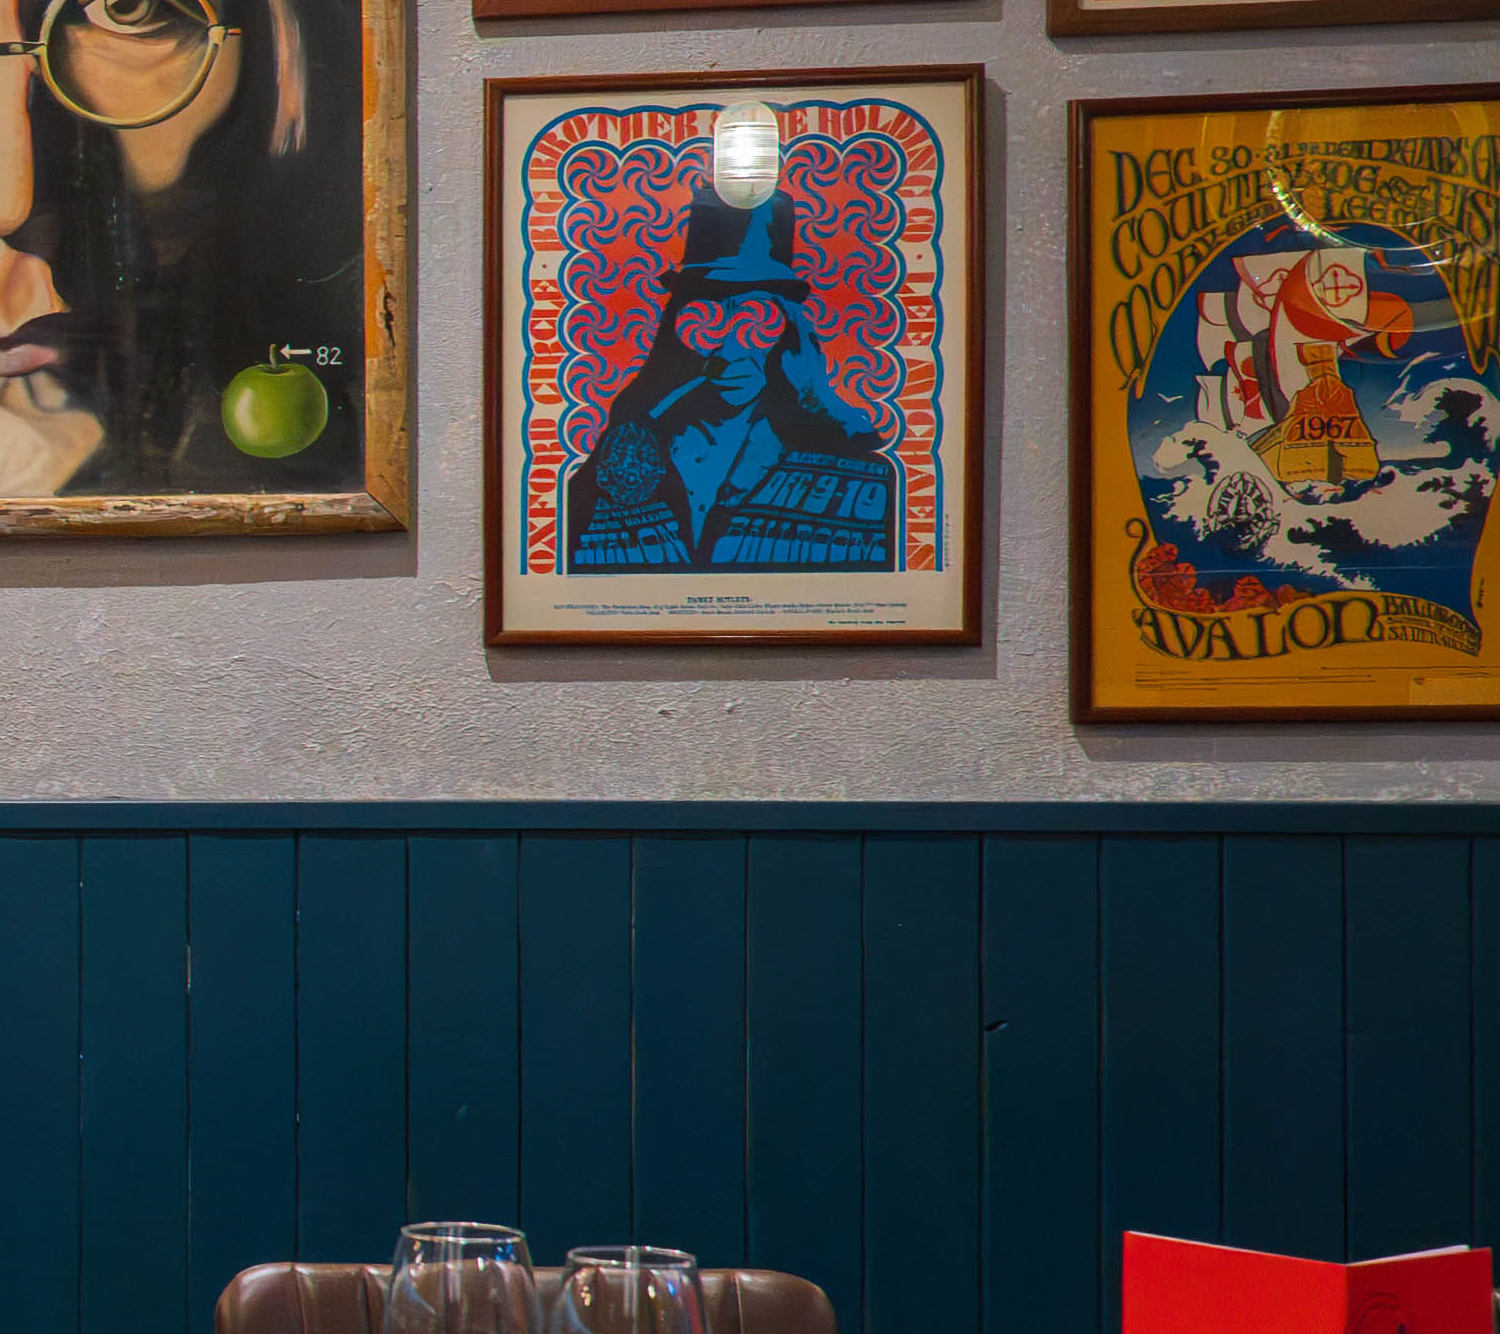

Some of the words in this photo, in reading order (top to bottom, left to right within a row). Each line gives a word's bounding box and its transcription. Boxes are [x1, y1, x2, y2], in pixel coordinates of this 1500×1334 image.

[528, 108, 700, 181] BROTHER
[530, 277, 563, 406] CIRCLE
[900, 270, 937, 348] LEE
[316, 346, 343, 366] 82
[1298, 416, 1354, 441] 1967
[528, 417, 562, 575] OXFORD
[1132, 597, 1385, 660] AVALON
